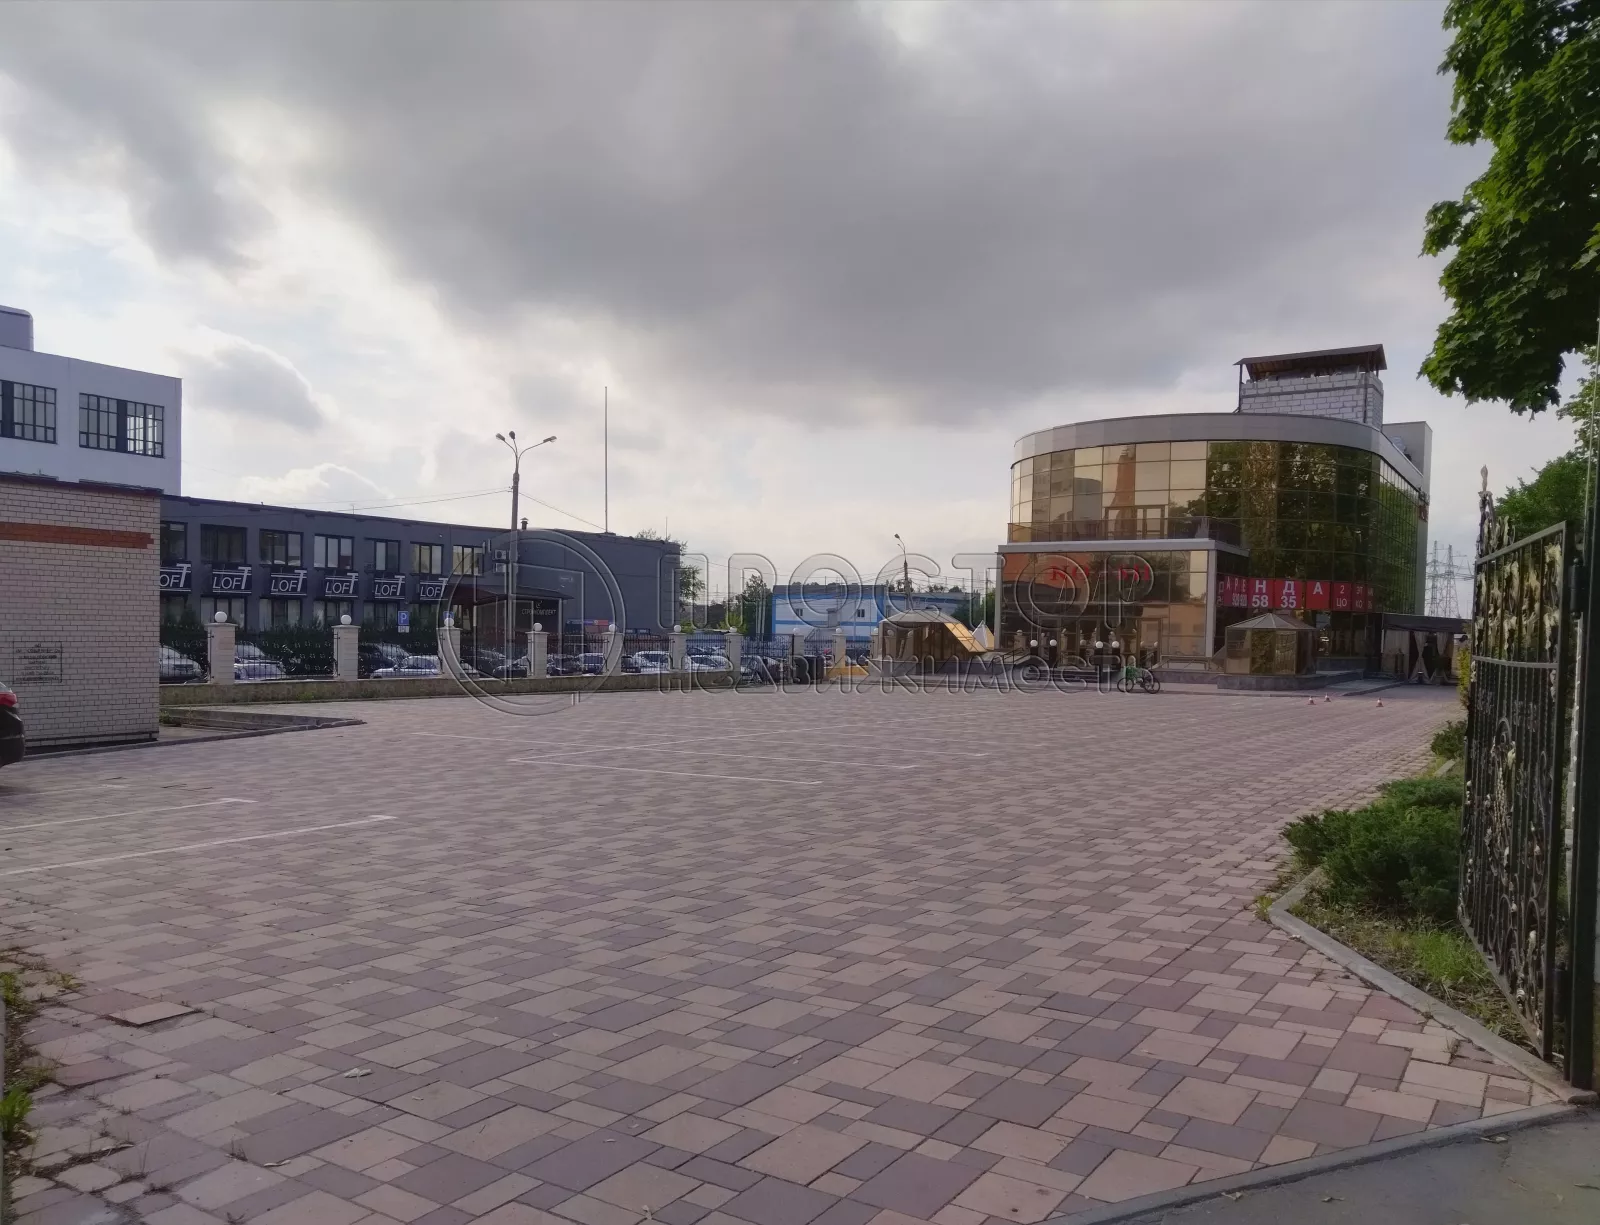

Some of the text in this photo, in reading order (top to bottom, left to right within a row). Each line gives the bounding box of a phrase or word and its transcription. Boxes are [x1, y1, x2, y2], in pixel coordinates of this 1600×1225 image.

[160, 563, 192, 588] OFT
[212, 566, 252, 590] LOFT
[270, 569, 308, 592] LOFT
[325, 572, 359, 594] LOFT
[374, 575, 406, 596] LOFT
[420, 577, 449, 598] LOFT
[1339, 584, 1345, 594] 2
[1251, 594, 1269, 608] 58
[1280, 595, 1297, 609] 35
